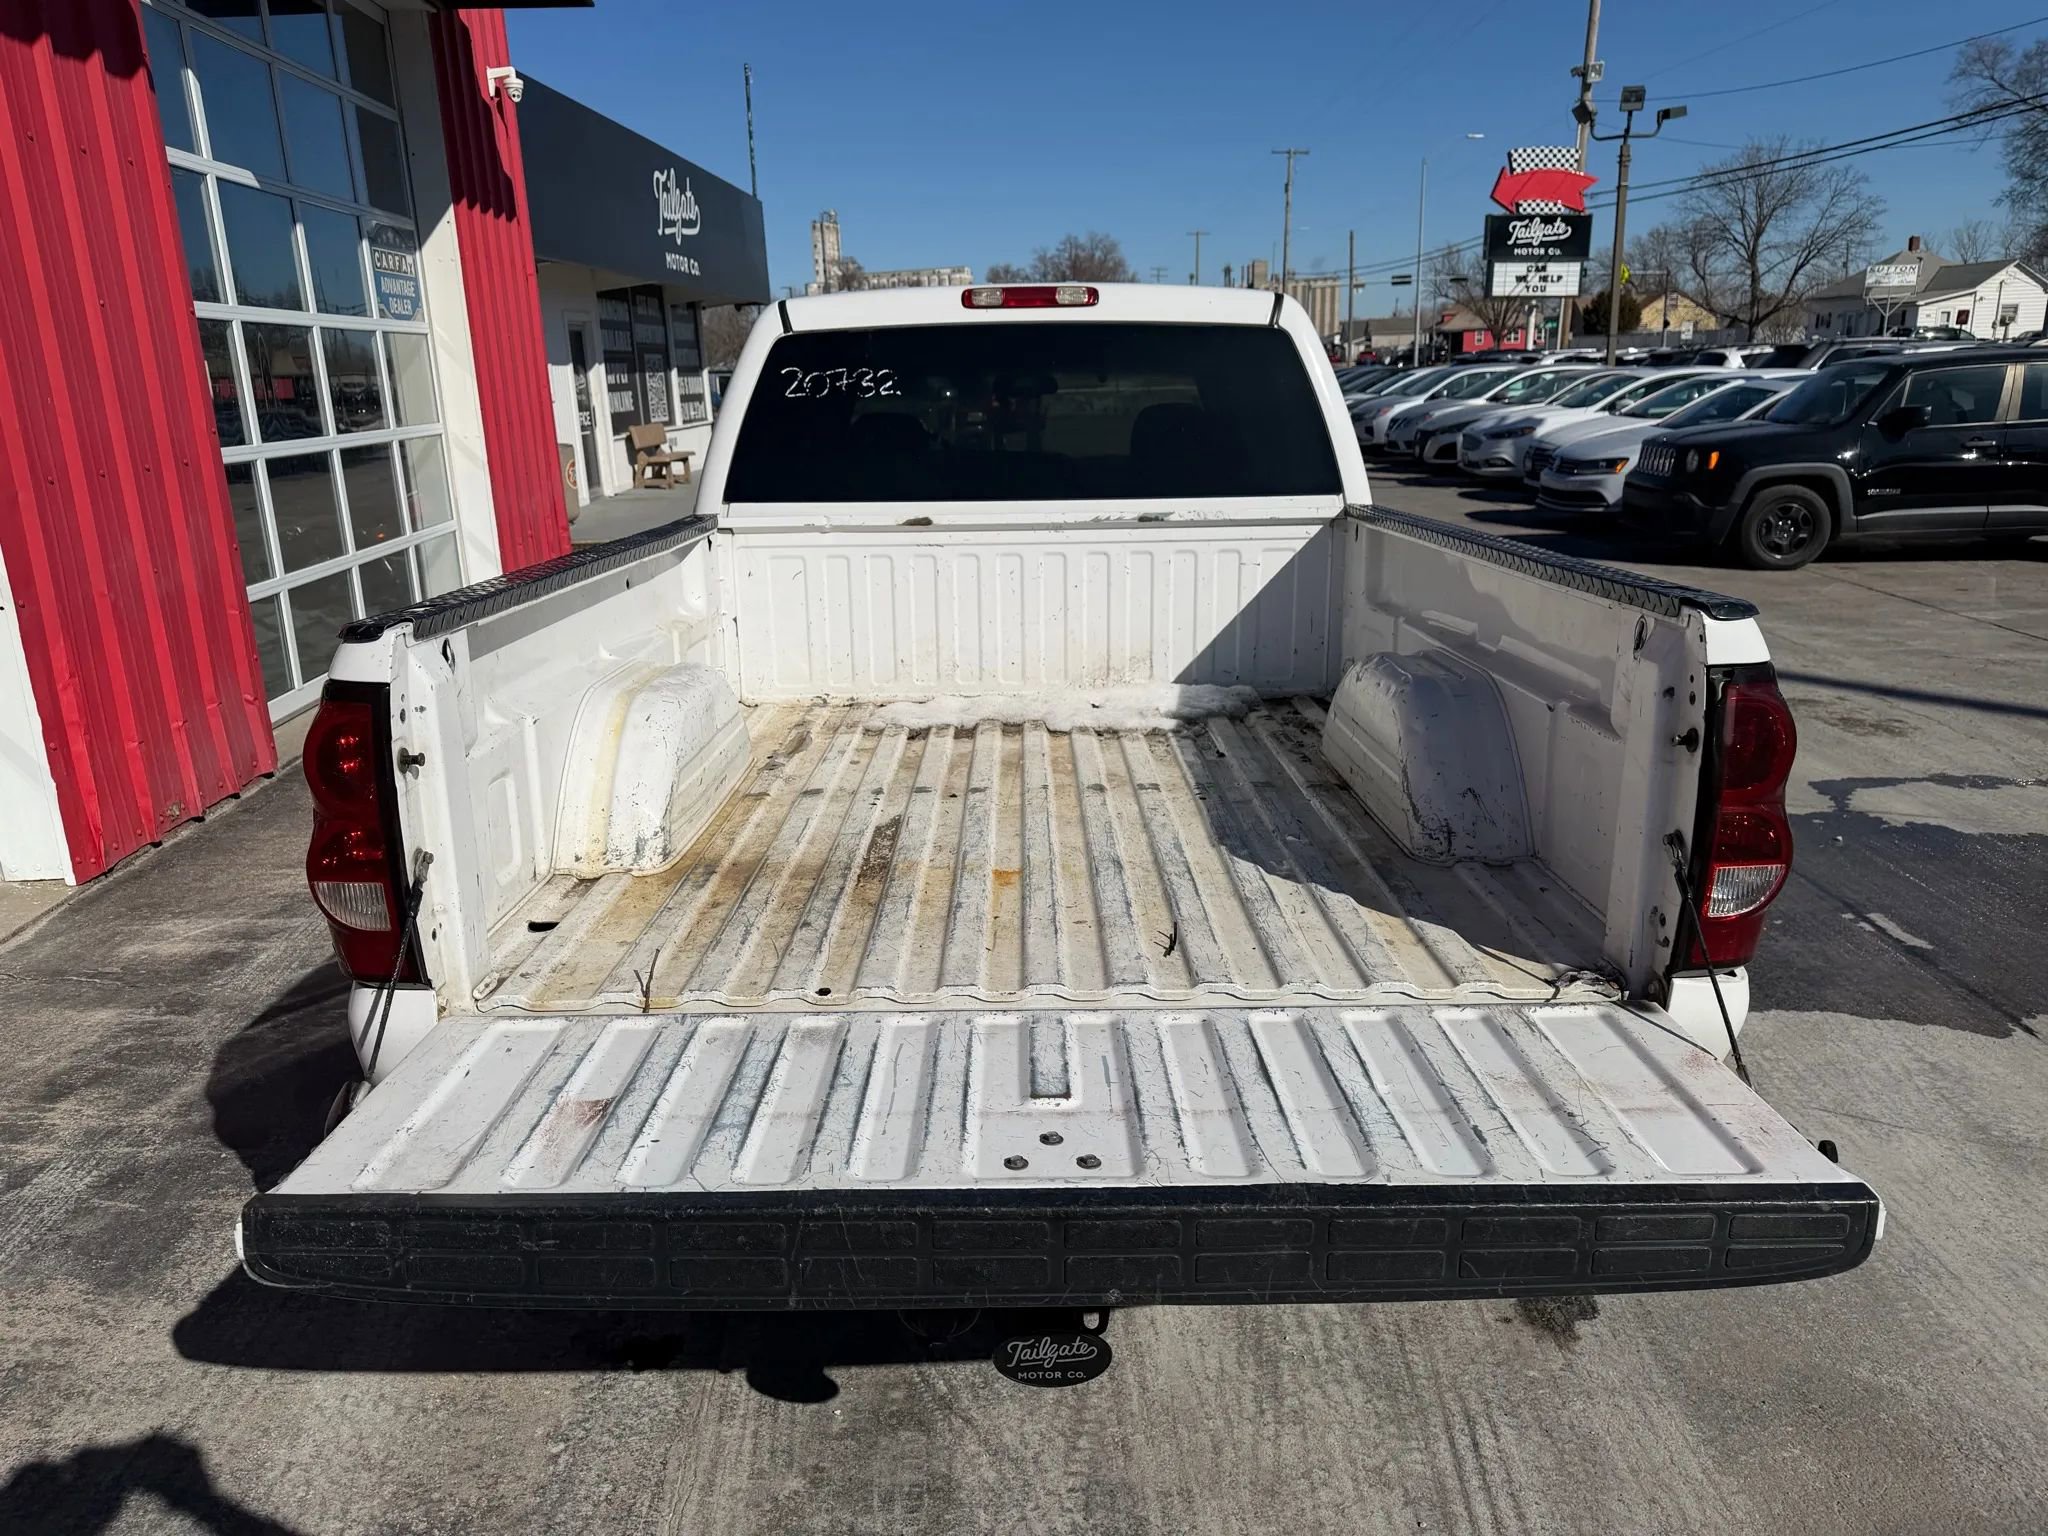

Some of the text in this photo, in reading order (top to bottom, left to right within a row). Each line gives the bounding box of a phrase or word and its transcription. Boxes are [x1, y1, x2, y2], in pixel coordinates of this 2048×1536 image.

[653, 167, 701, 246] Tailgate
[1506, 216, 1572, 246] Tailgate
[1513, 247, 1546, 256] MOTOR
[373, 249, 416, 276] CARFAX
[665, 251, 701, 276] MOTOR CO.
[1526, 265, 1548, 273] CAN
[380, 276, 416, 297] ADVANTAGE
[1524, 285, 1547, 293] YOU
[1538, 275, 1563, 283] HELP
[388, 296, 413, 315] DEALER
[1007, 1335, 1098, 1368] Tailgate
[1018, 1370, 1087, 1379] MOTOR CO.
